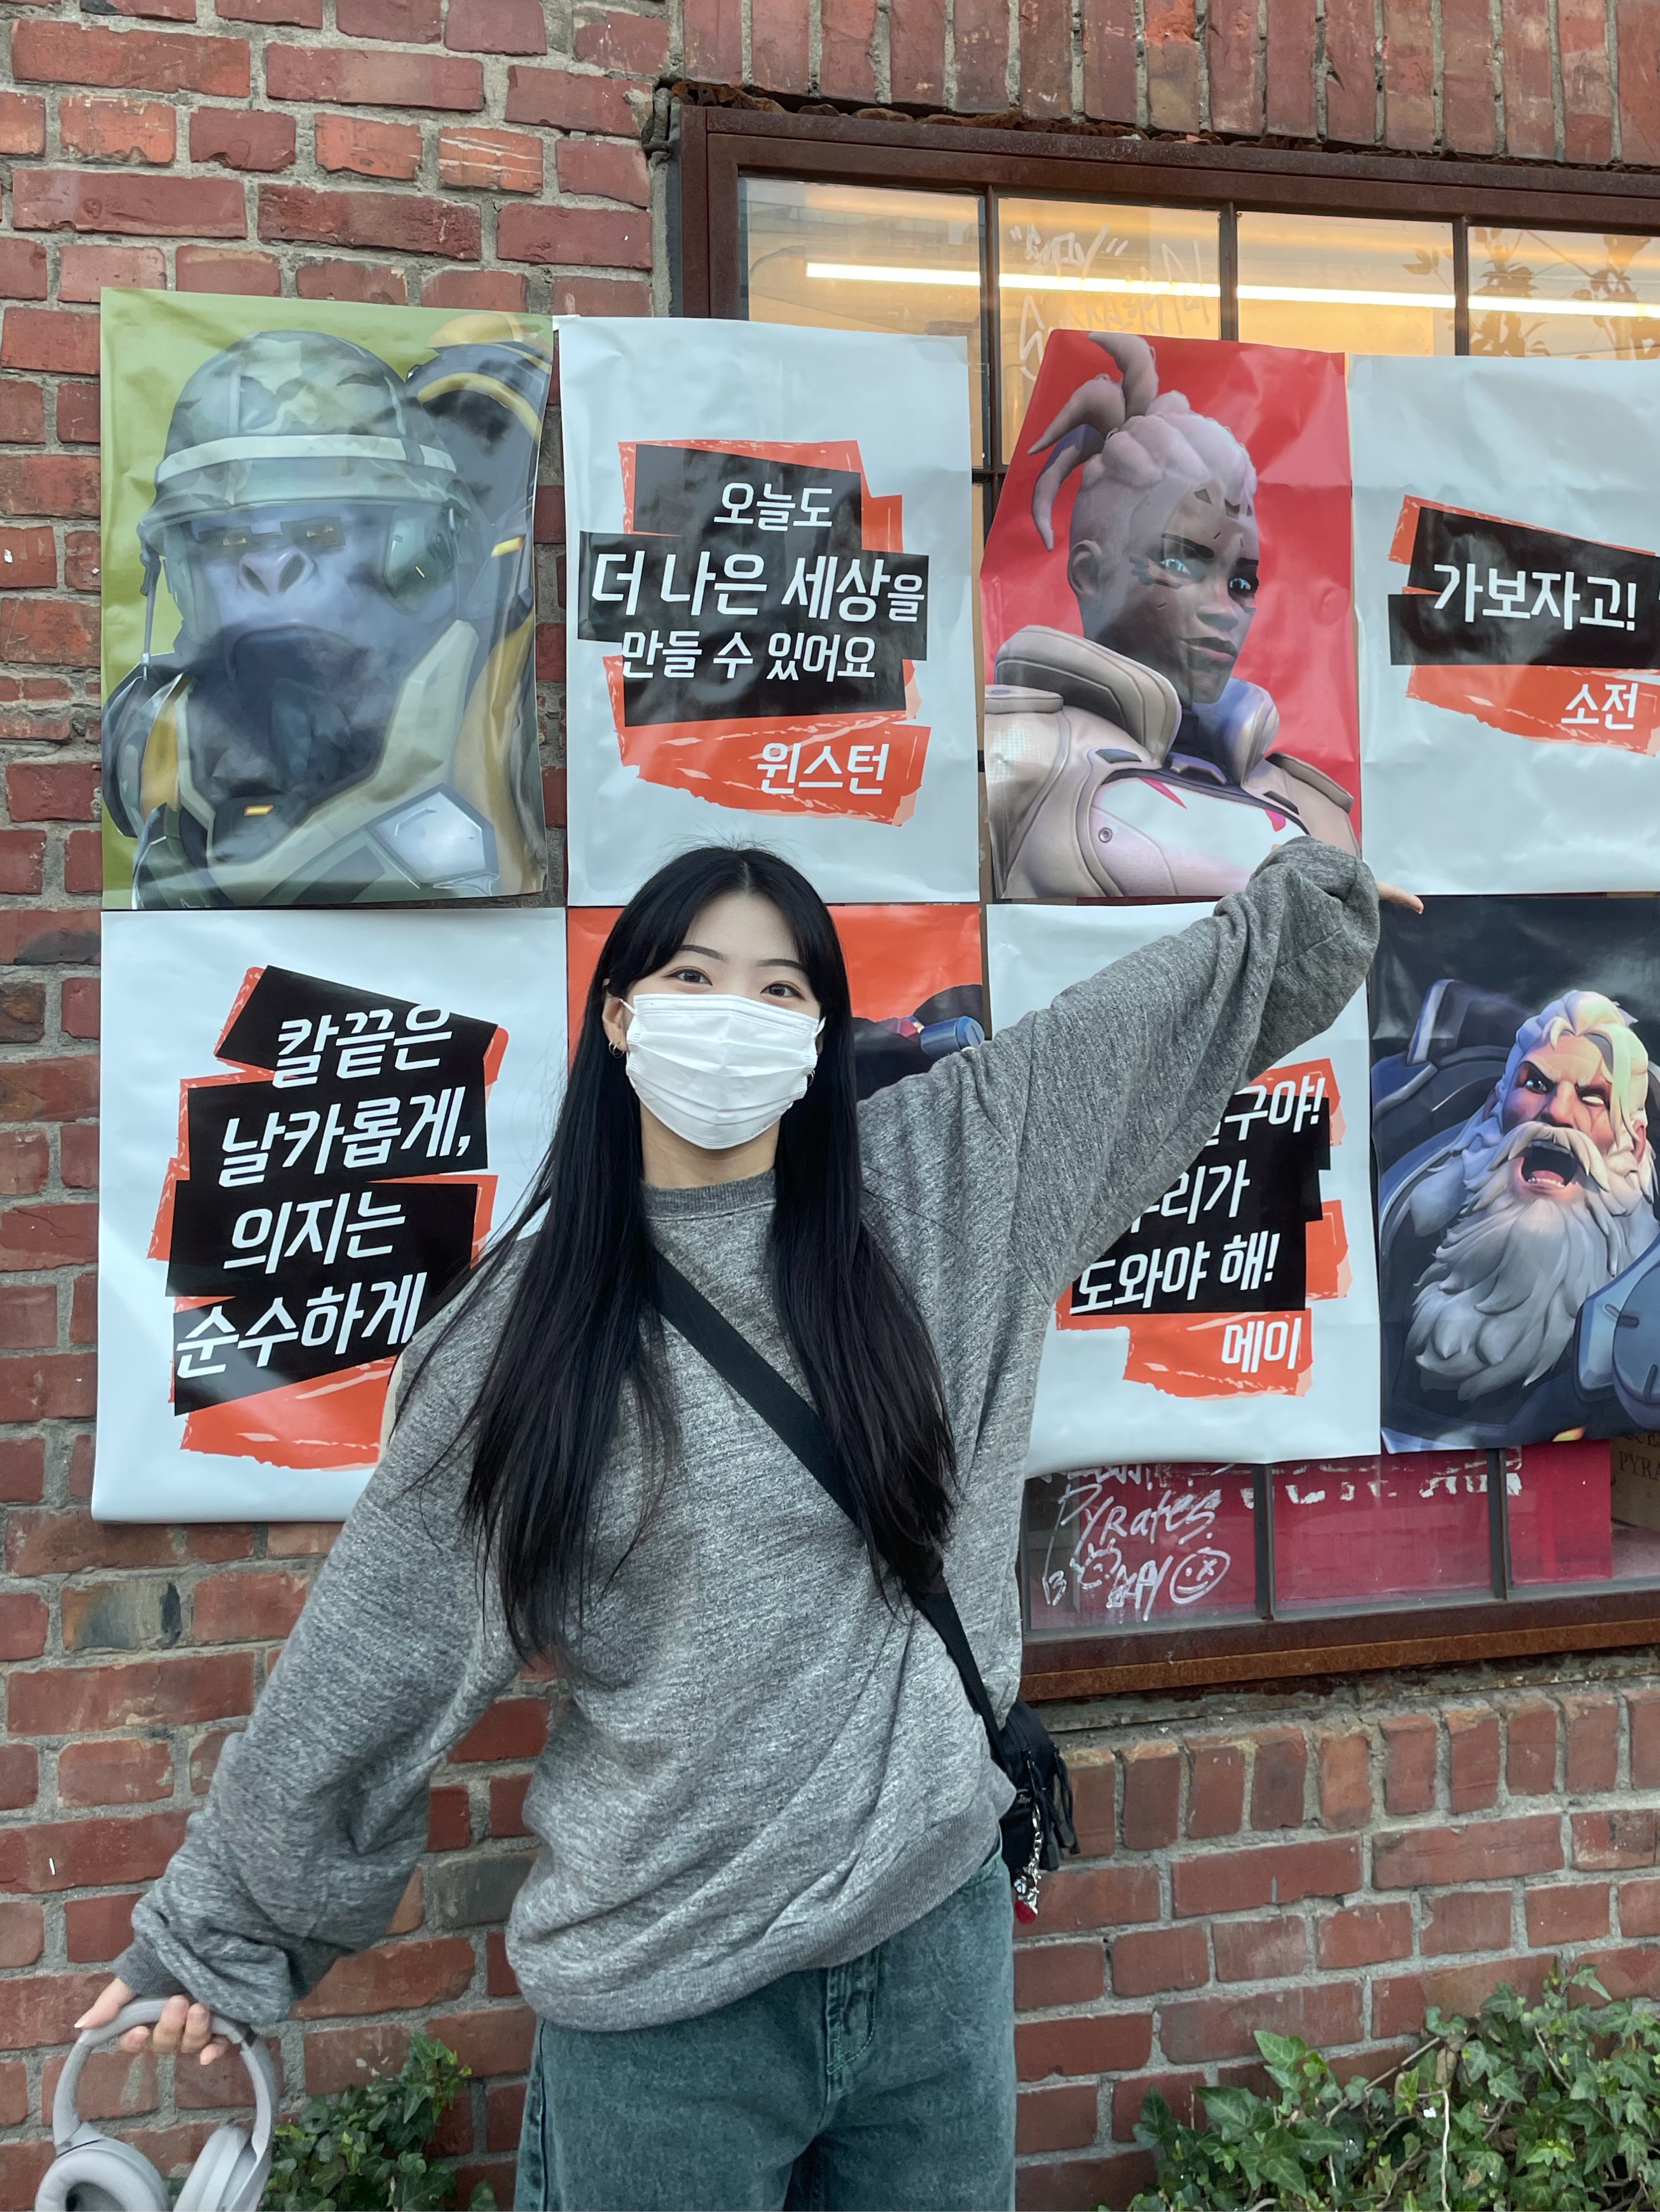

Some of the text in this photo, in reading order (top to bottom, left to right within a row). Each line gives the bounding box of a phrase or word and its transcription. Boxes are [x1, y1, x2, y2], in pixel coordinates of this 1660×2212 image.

[713, 482, 833, 532] 오늘도
[591, 550, 926, 622] 더 나은 세상을
[1433, 563, 1637, 631] 가보자고!
[621, 629, 876, 682] 만들 수 있어요
[1560, 683, 1639, 730] 소전
[756, 742, 890, 795] 윈스턴
[271, 1005, 453, 1089] 칼끝은
[217, 1086, 472, 1188] 날카롭게,
[1205, 1075, 1326, 1146] 구야!
[223, 1190, 406, 1275] 의지는
[1069, 1230, 1281, 1315] 도와야 해!
[175, 1272, 428, 1379] 순수하게
[1220, 1317, 1302, 1373] 메이
